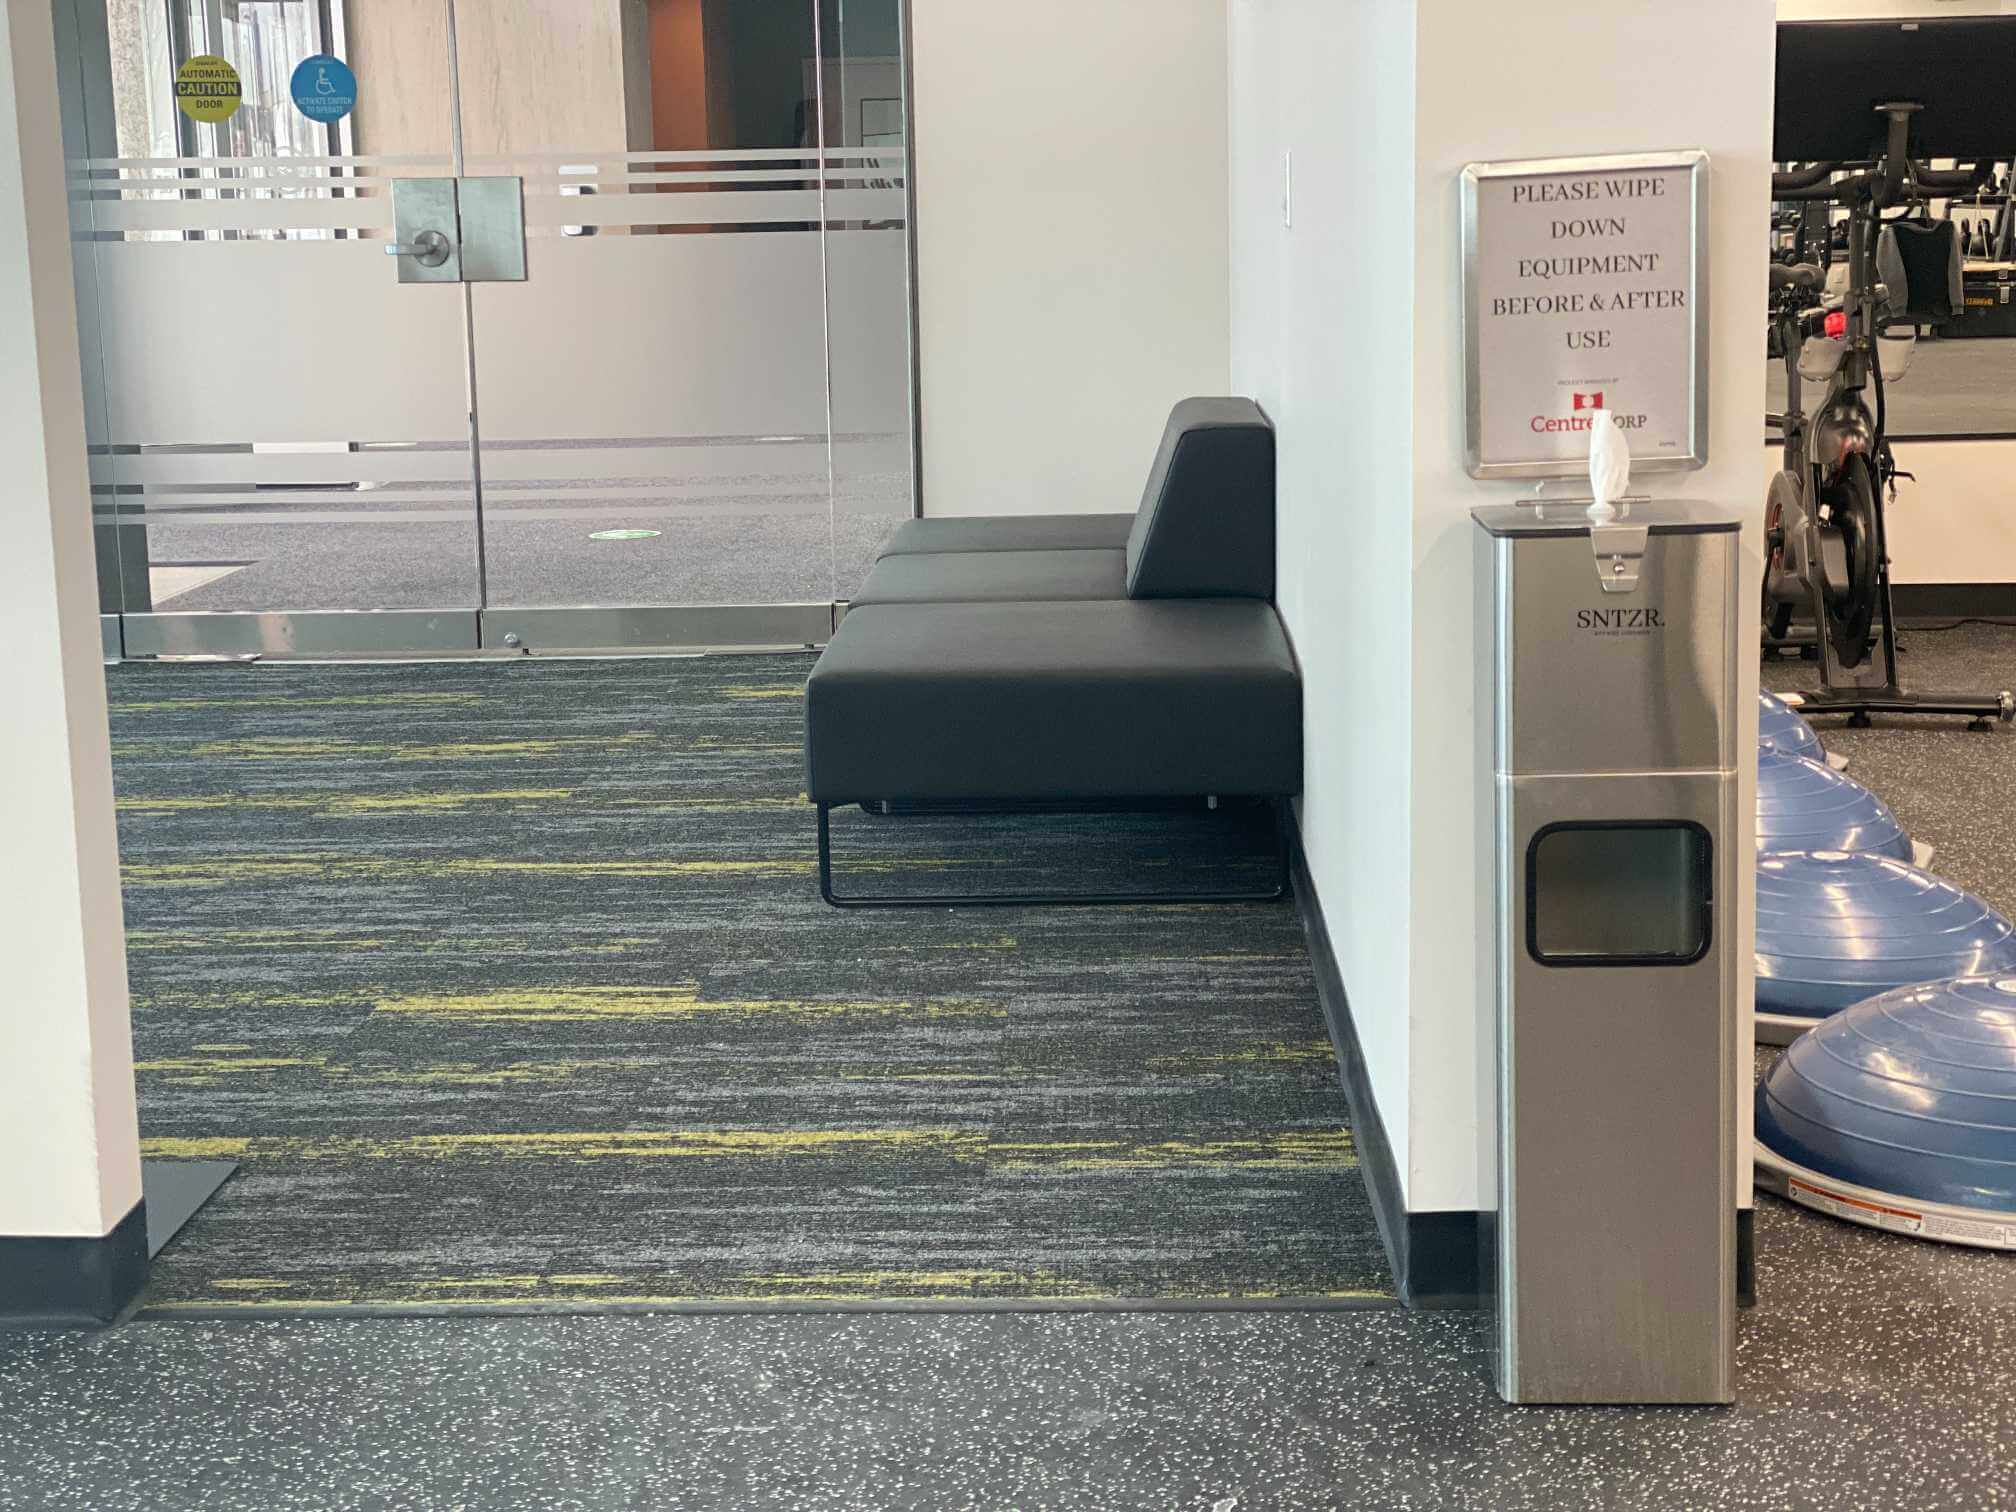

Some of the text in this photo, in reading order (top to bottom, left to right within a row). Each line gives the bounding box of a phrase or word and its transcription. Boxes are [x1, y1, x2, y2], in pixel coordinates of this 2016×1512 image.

[180, 69, 236, 79] AUTOMATIC
[178, 83, 238, 95] CAUTION
[196, 100, 223, 109] DOOR
[1512, 177, 1665, 204] PLEASE WIPE
[1551, 217, 1626, 239] DOWN
[1518, 253, 1659, 280] EQUIPMENT
[1492, 289, 1685, 317] BEFORE & AFTER
[1566, 330, 1611, 350] USE
[1576, 608, 1665, 629] SNTZR.
